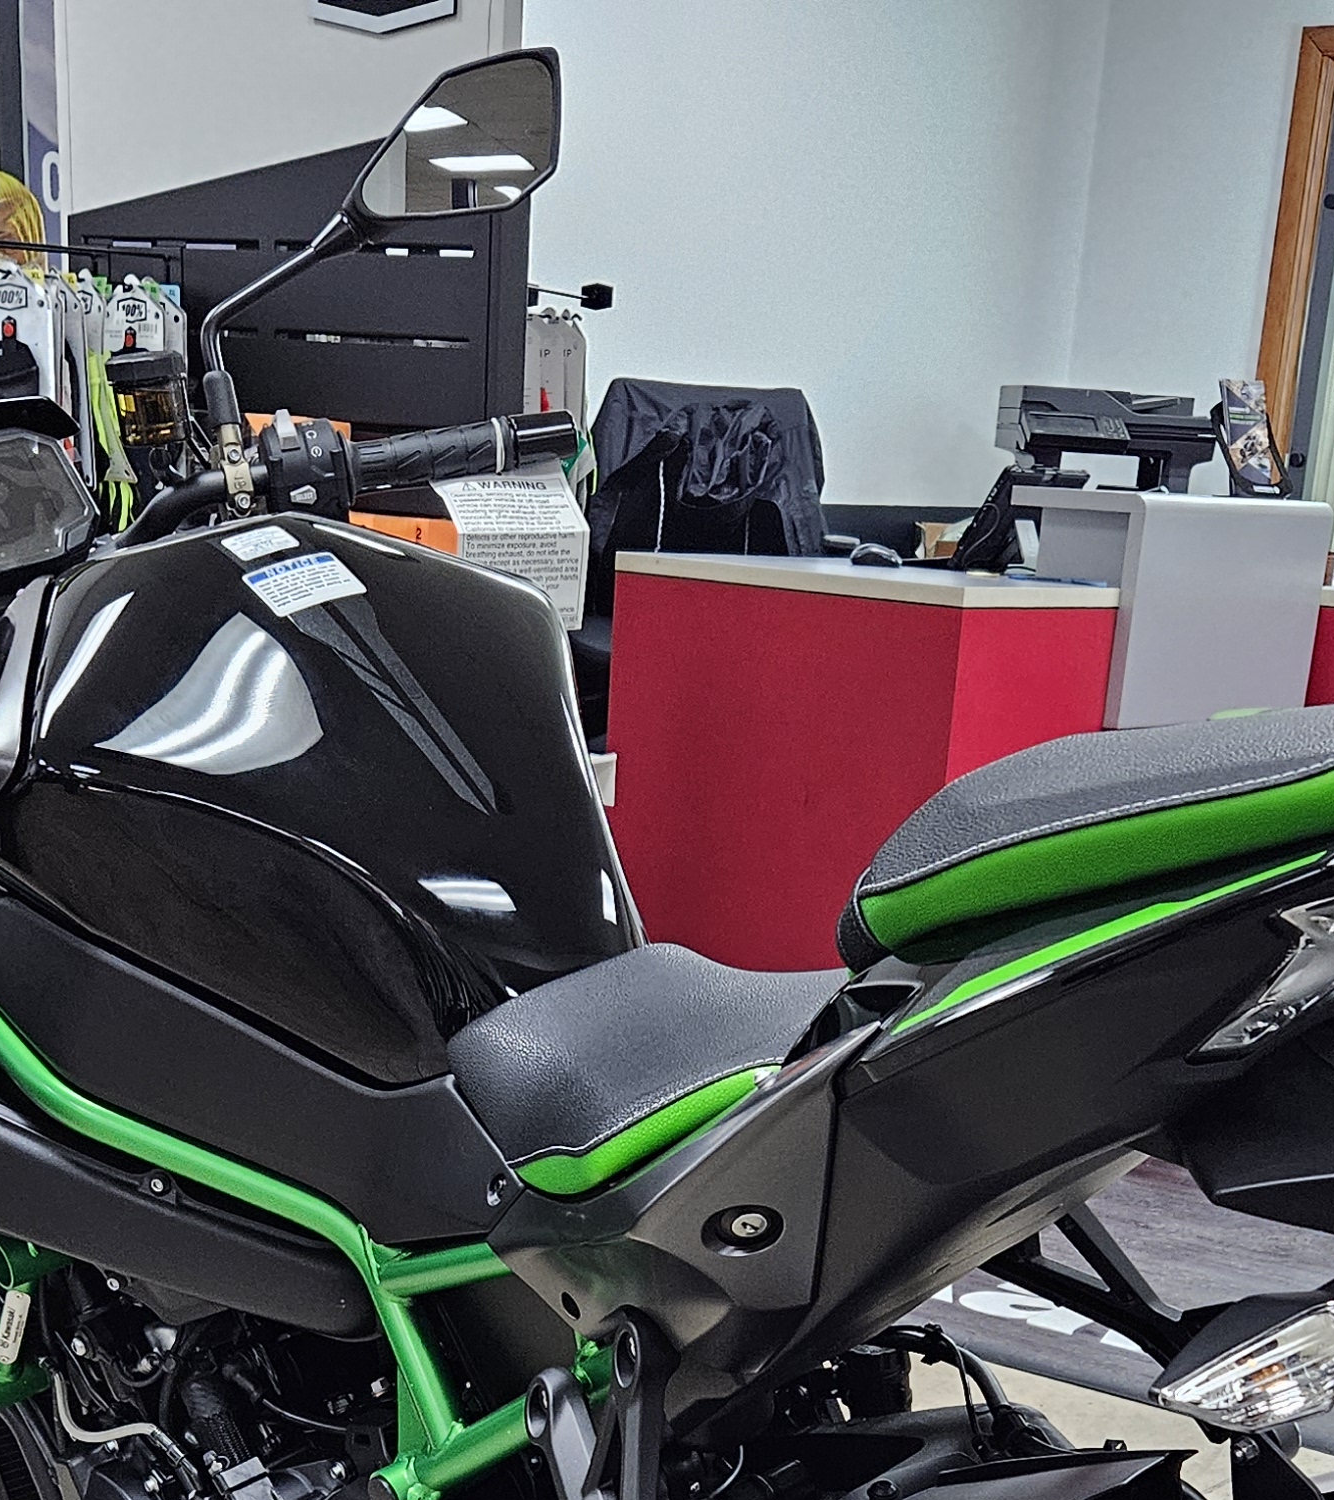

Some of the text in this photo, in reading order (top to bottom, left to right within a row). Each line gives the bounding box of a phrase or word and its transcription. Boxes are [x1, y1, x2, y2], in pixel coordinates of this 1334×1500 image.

[478, 481, 546, 490] WARNING
[415, 527, 422, 540] 2
[466, 549, 496, 559] breathing
[498, 549, 524, 559] exhaust,
[489, 558, 511, 567] except
[512, 558, 520, 567] as
[522, 558, 555, 567] necessary,
[519, 566, 563, 574] well-ventilated
[545, 574, 558, 582] your
[1, 1306, 16, 1341] Kawasaki
